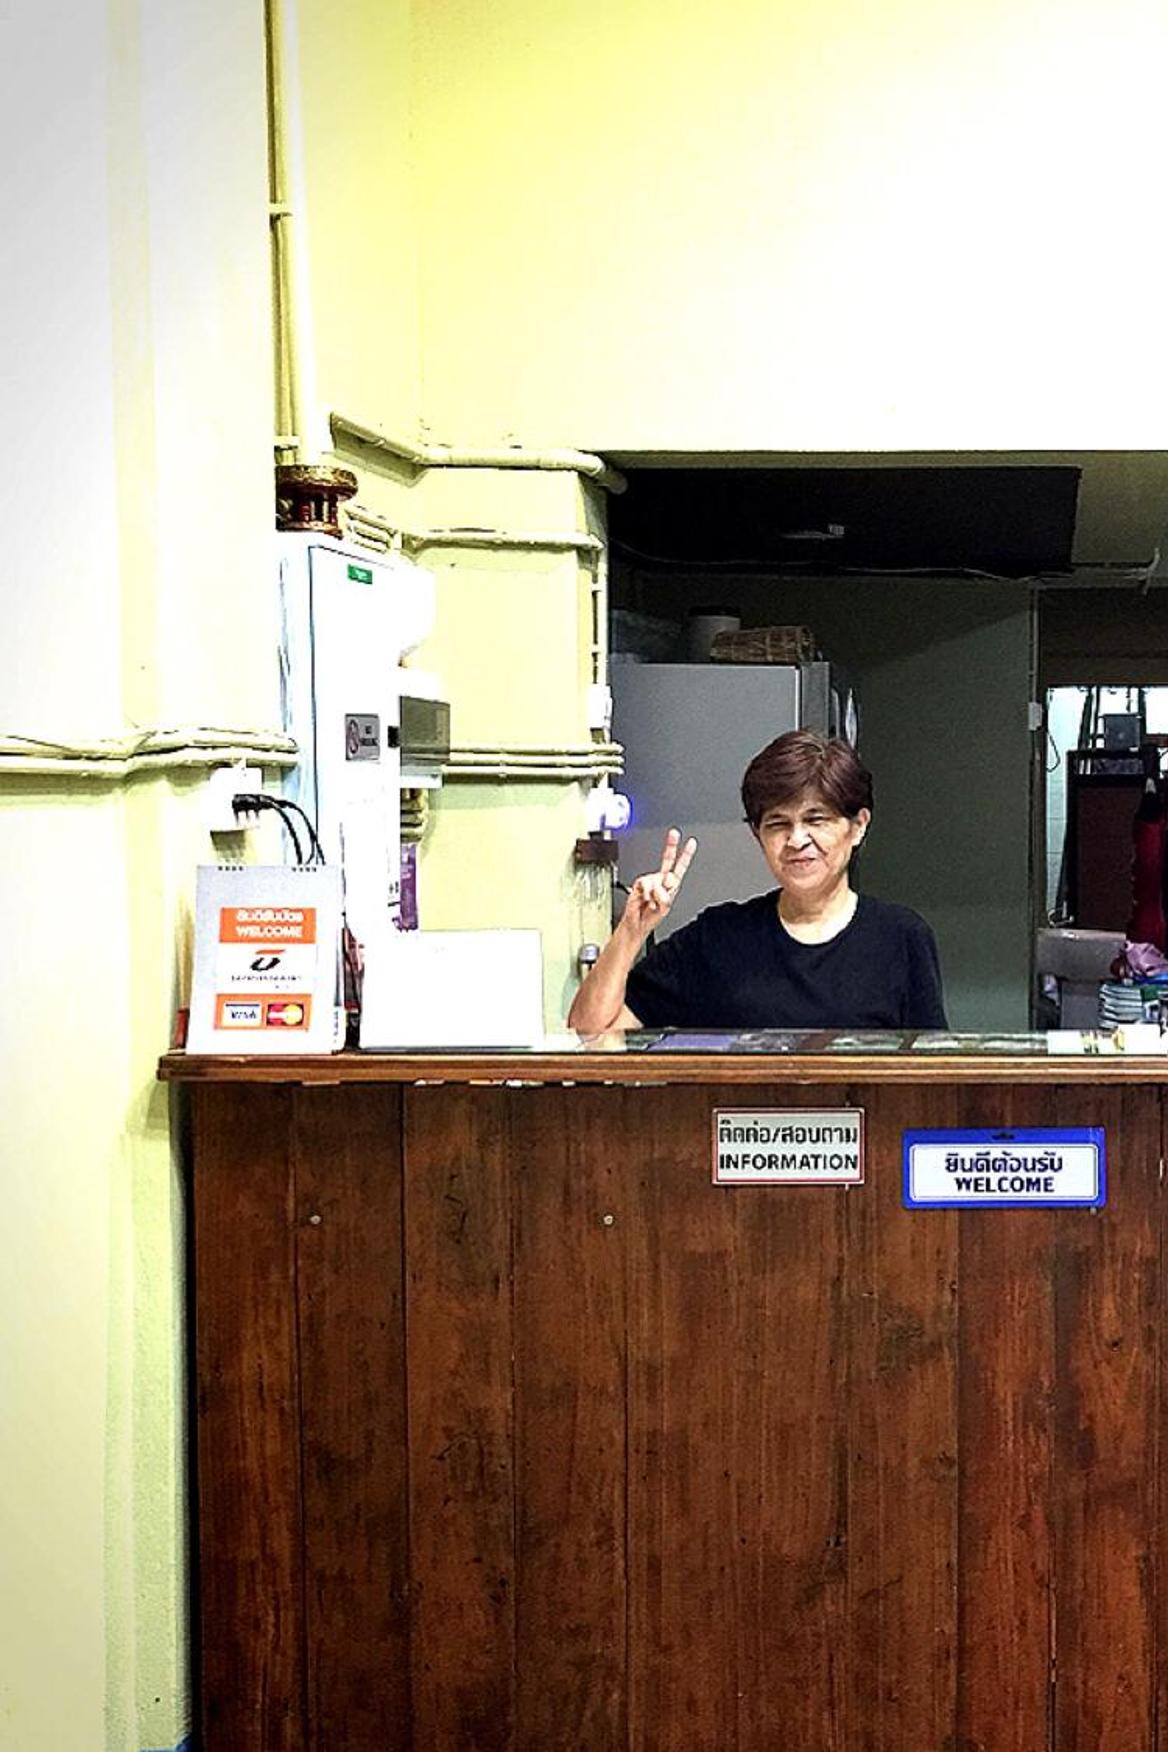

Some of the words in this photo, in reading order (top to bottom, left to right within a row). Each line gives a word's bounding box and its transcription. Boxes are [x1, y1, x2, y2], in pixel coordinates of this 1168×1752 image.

[235, 925, 303, 938] WELCOME
[719, 1153, 858, 1170] INFORMATION
[945, 1150, 1063, 1173] ยินดีต้อนรับ
[954, 1176, 1055, 1193] WELCOME
